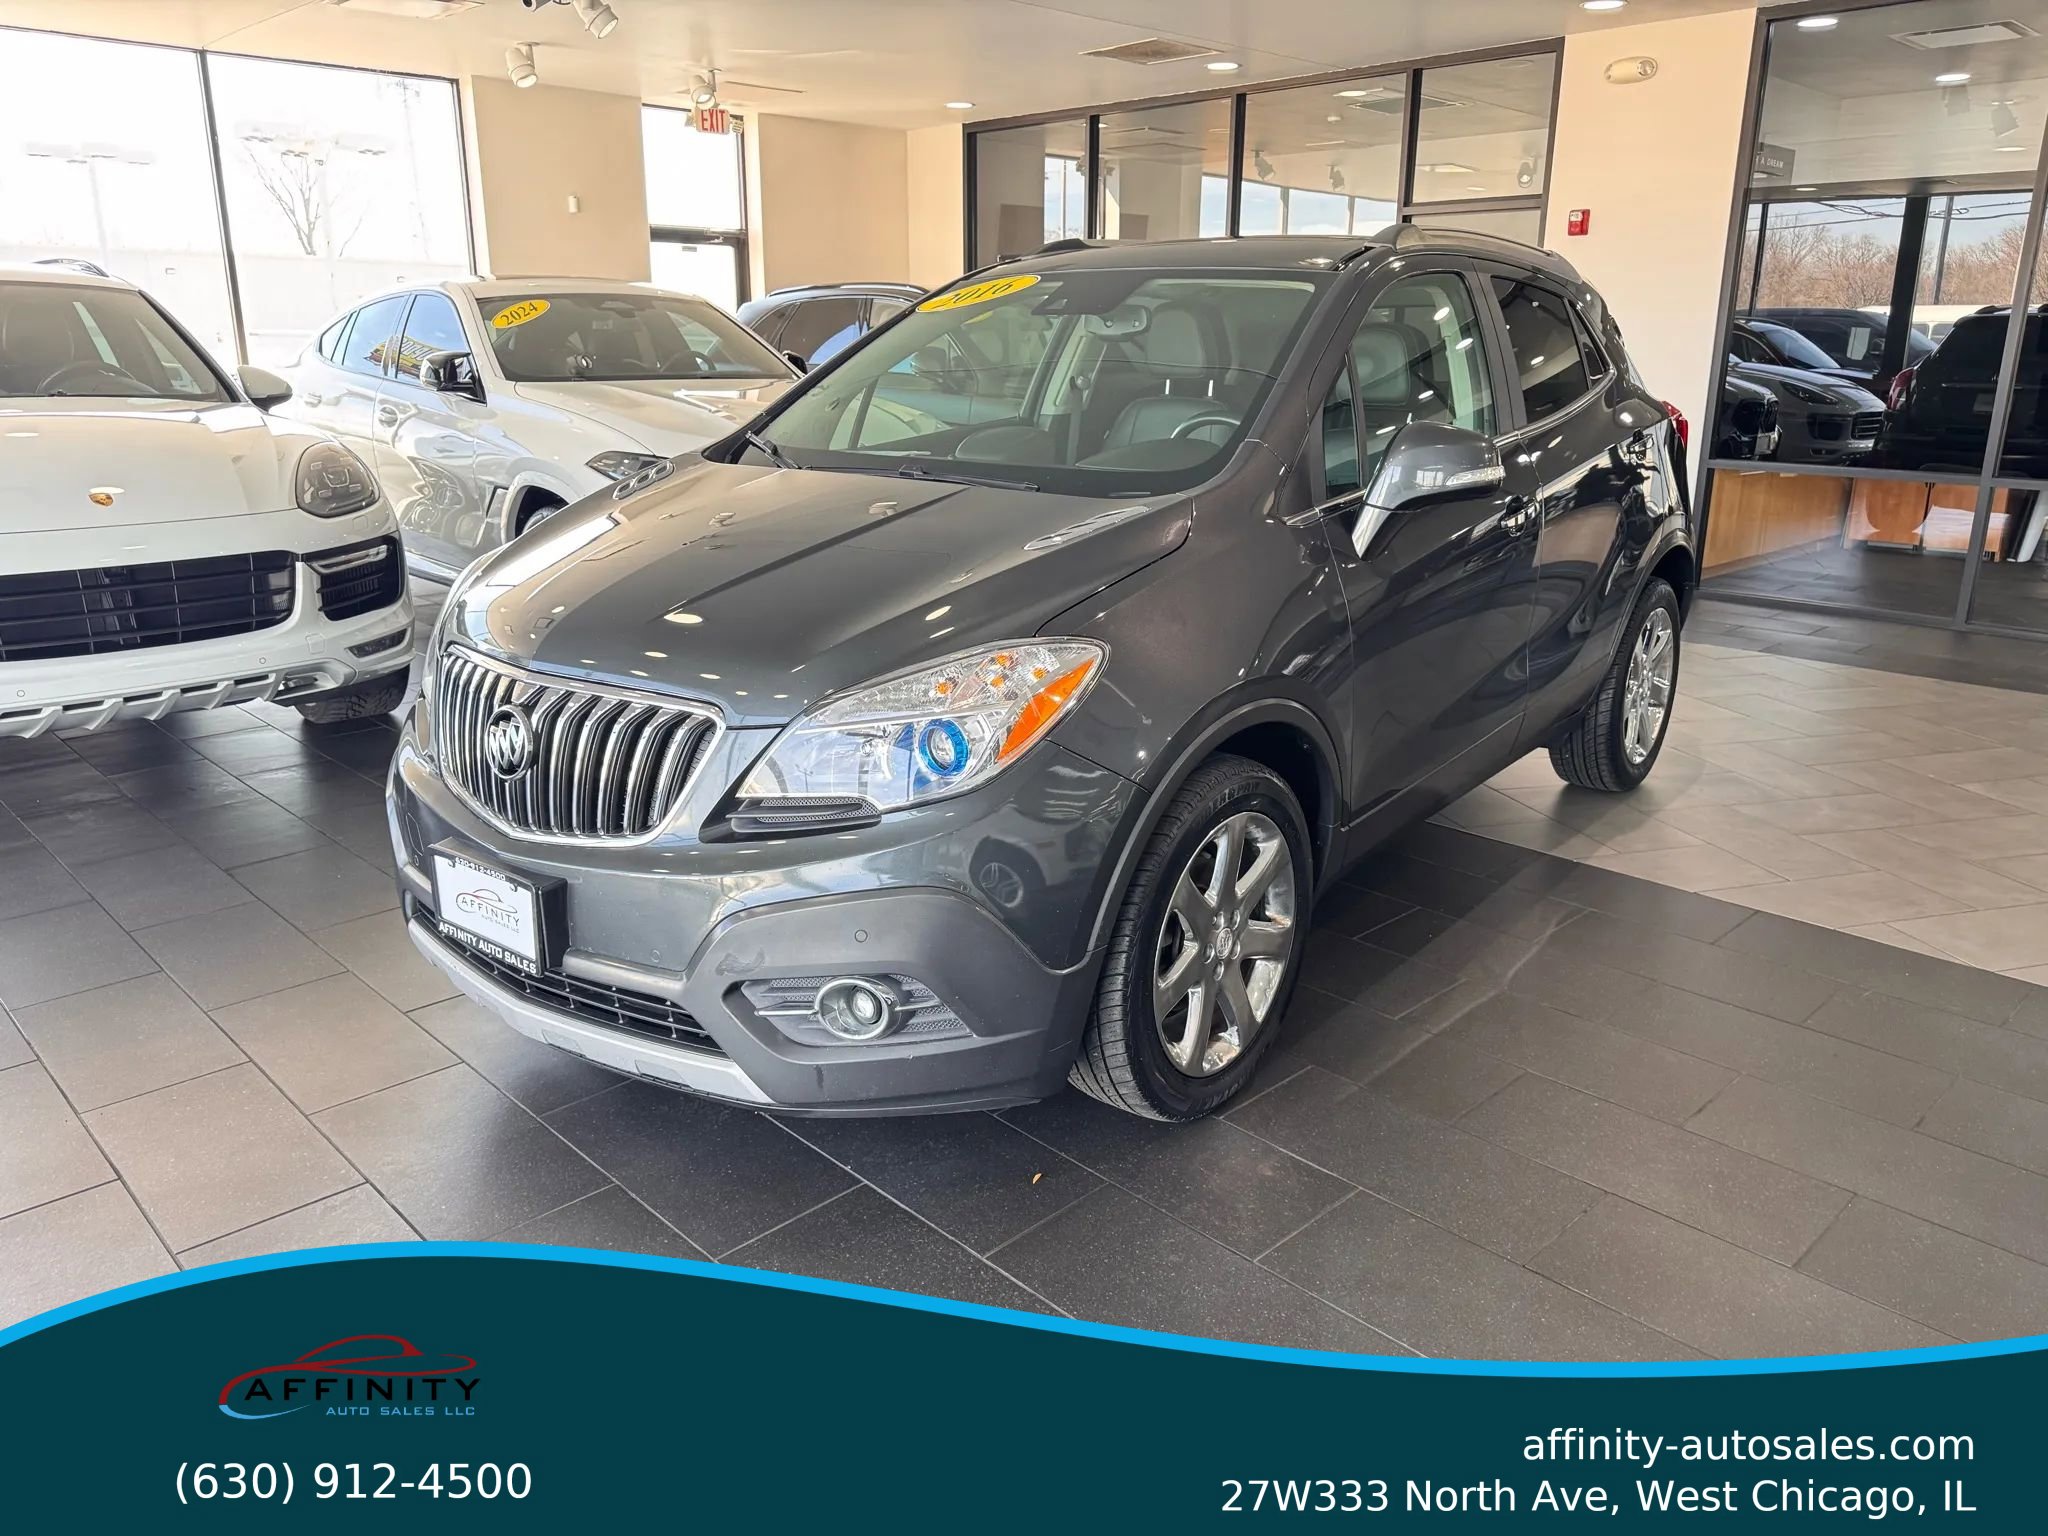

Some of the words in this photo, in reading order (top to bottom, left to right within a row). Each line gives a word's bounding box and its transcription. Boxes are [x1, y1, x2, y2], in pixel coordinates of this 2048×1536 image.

[701, 108, 726, 134] EXIT
[500, 302, 538, 326] 2024
[461, 896, 520, 927] AFFINITY
[439, 922, 478, 947] AFFINITY
[479, 939, 502, 957] AUTO
[504, 951, 536, 974] SALES
